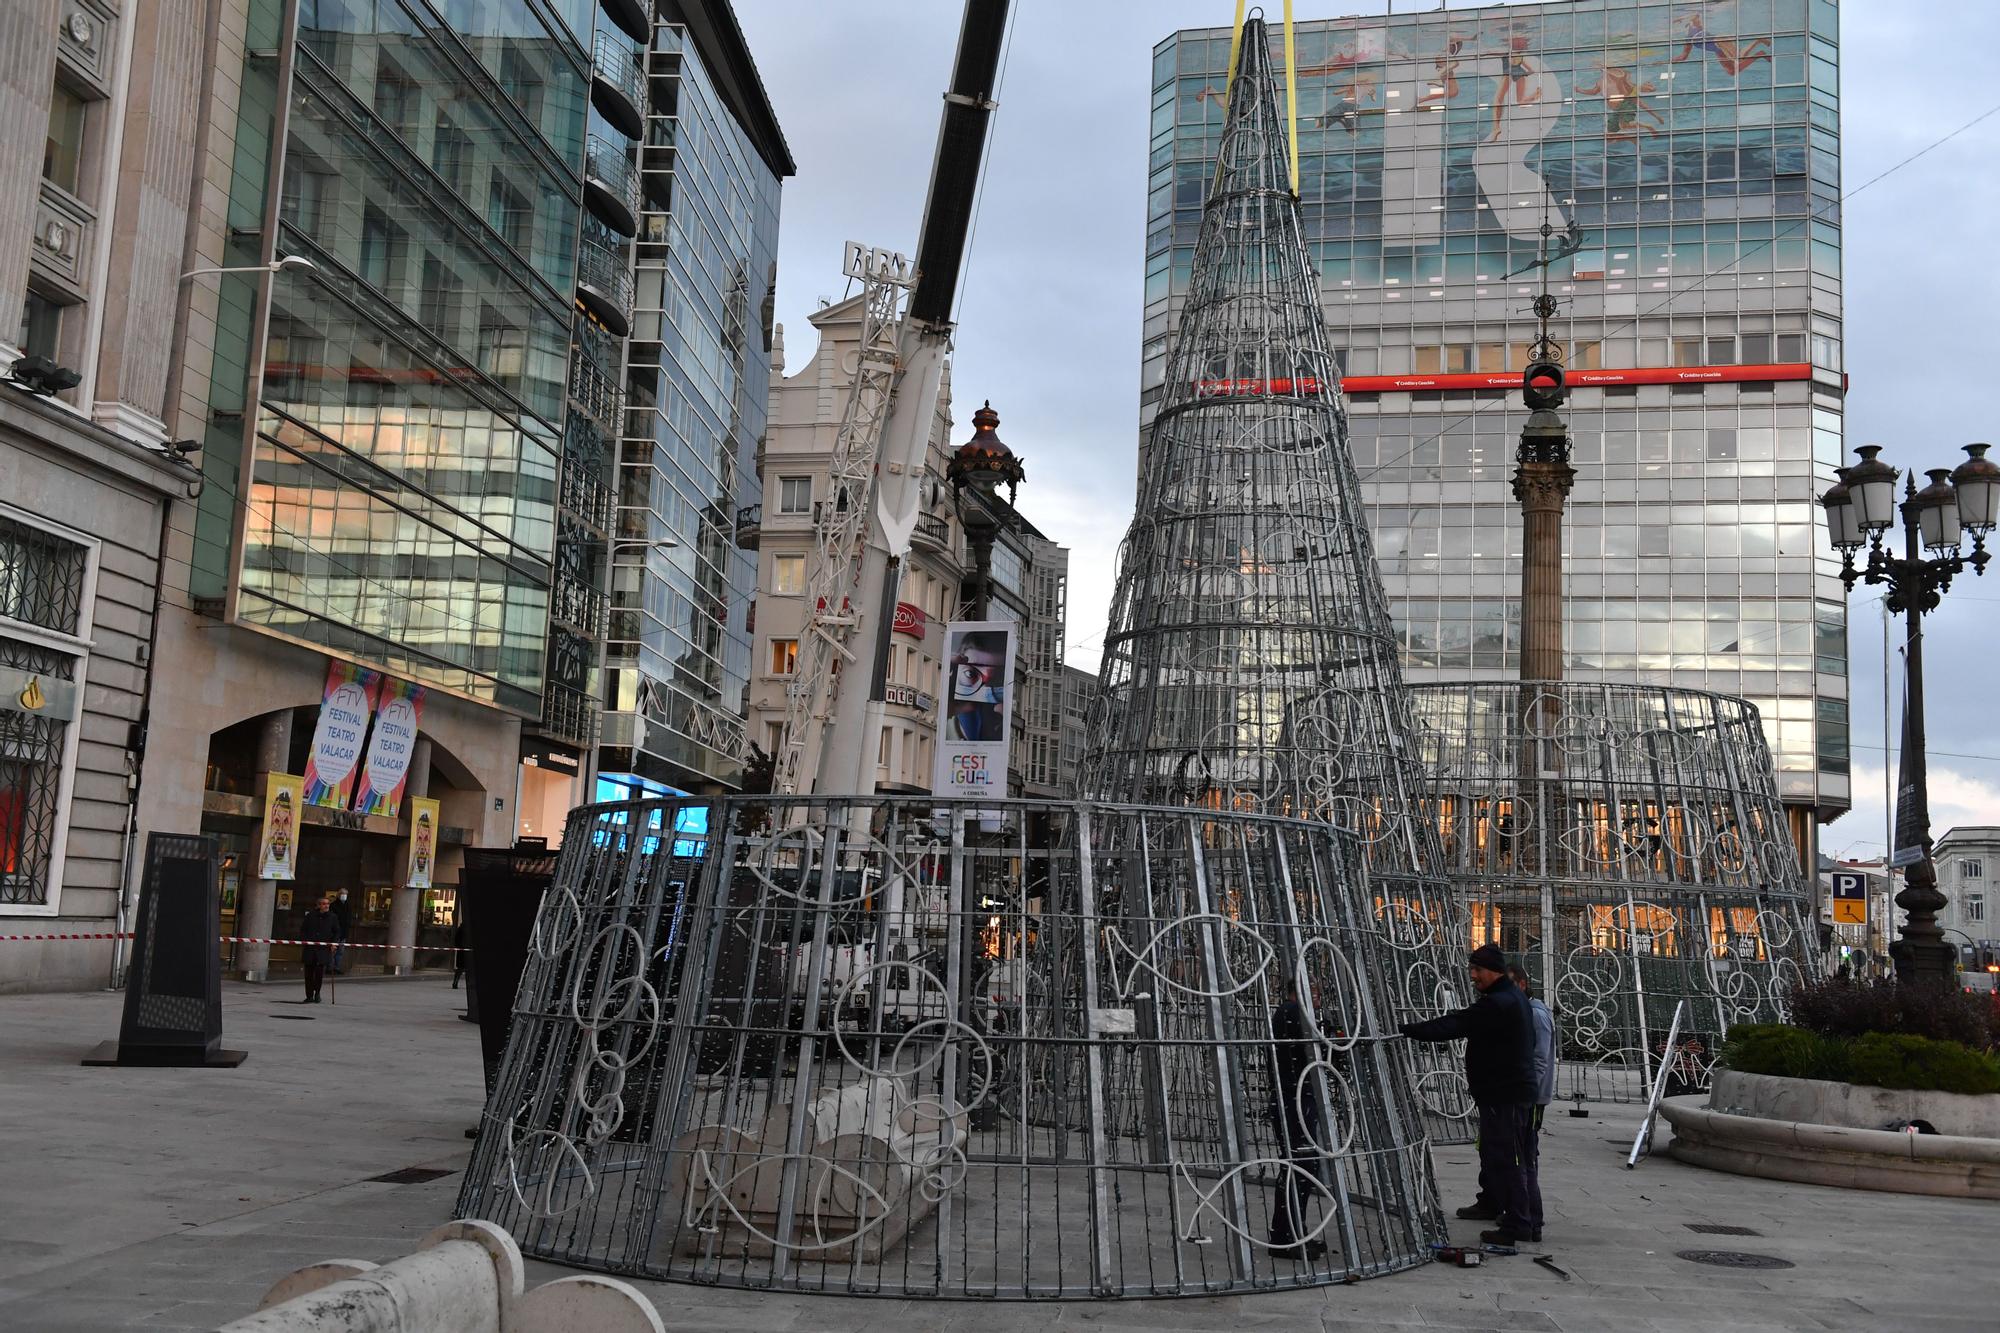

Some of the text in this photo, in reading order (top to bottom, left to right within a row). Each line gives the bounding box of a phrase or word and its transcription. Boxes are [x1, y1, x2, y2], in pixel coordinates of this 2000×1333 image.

[328, 708, 361, 726] FESTIVAL
[327, 726, 356, 743] TEATRO
[381, 722, 410, 738] FESTIVAL
[320, 743, 355, 761] VALACAR
[379, 739, 405, 754] TEATRO
[373, 755, 404, 771] VALACAR
[952, 755, 988, 770] FEST
[1840, 876, 1857, 896] P
